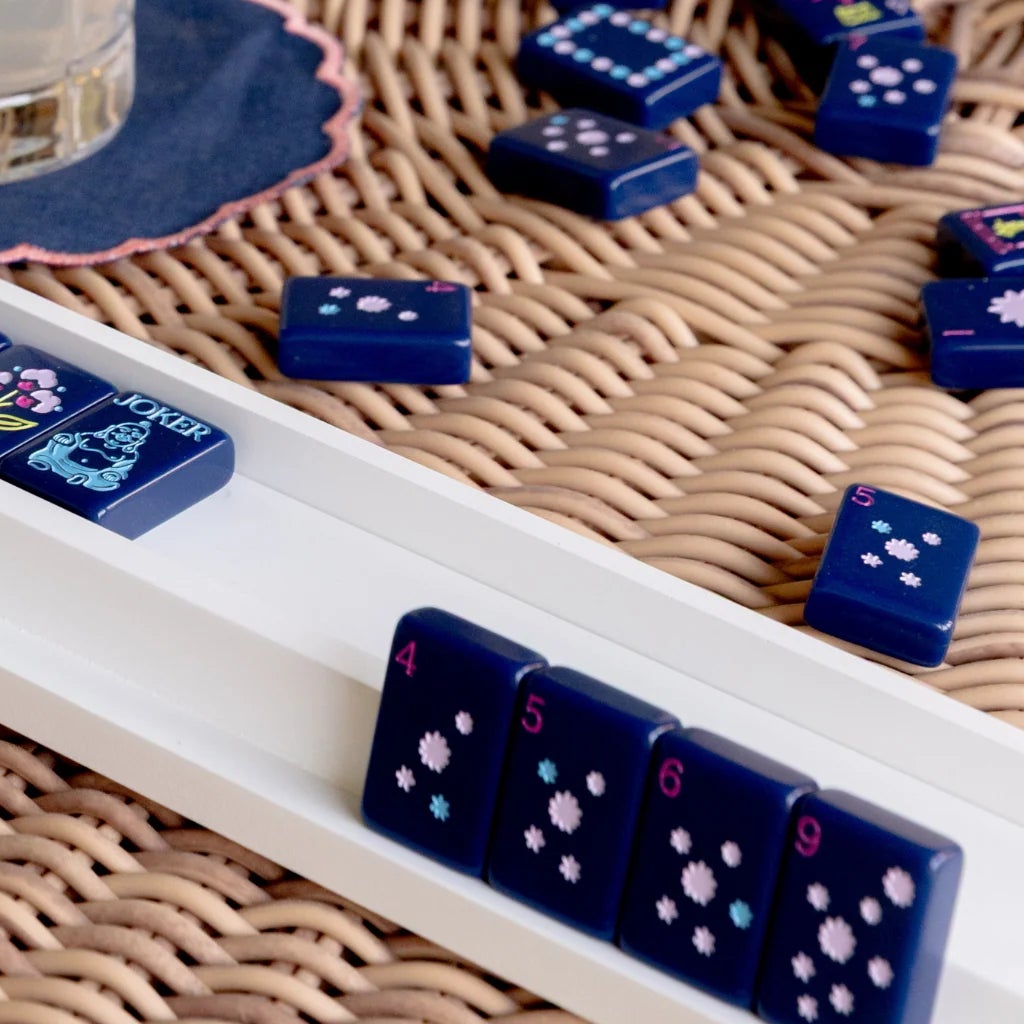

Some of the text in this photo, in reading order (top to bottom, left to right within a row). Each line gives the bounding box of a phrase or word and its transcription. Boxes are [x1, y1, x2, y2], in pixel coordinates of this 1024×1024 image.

[112, 393, 212, 442] JOKER
[851, 486, 875, 507] 5
[394, 640, 417, 677] 4
[521, 694, 545, 734] 5
[658, 758, 684, 798] 6
[795, 817, 822, 857] 9
